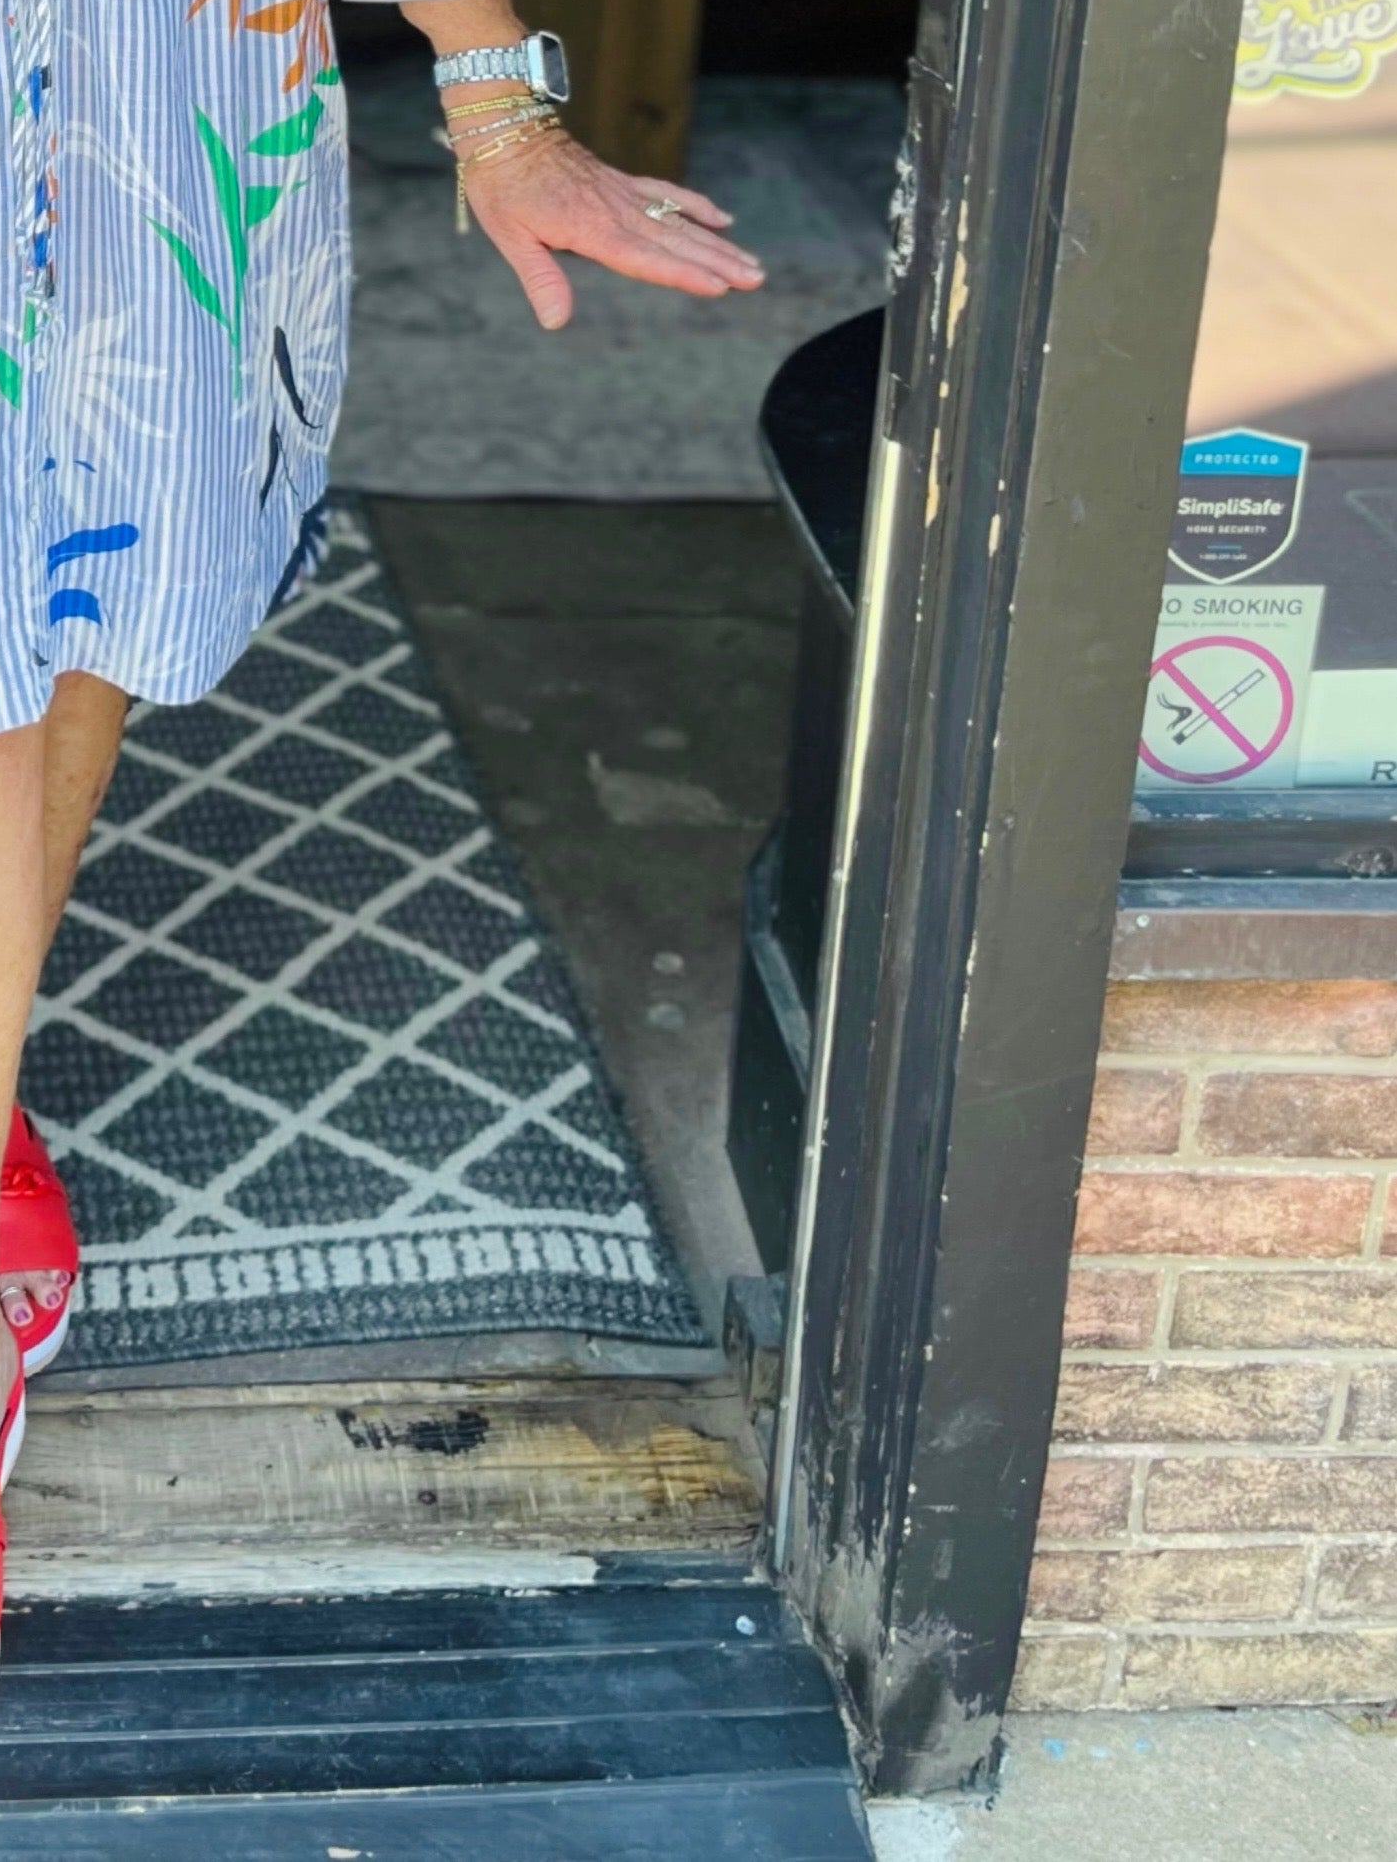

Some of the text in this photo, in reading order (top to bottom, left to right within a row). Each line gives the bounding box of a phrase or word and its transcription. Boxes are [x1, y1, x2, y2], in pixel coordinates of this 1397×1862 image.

[1194, 453, 1280, 465] PROTECTED
[1177, 497, 1284, 519] SimpliSafe
[1186, 525, 1267, 534] HOME SECURITY
[1164, 598, 1303, 615] O SMOKING
